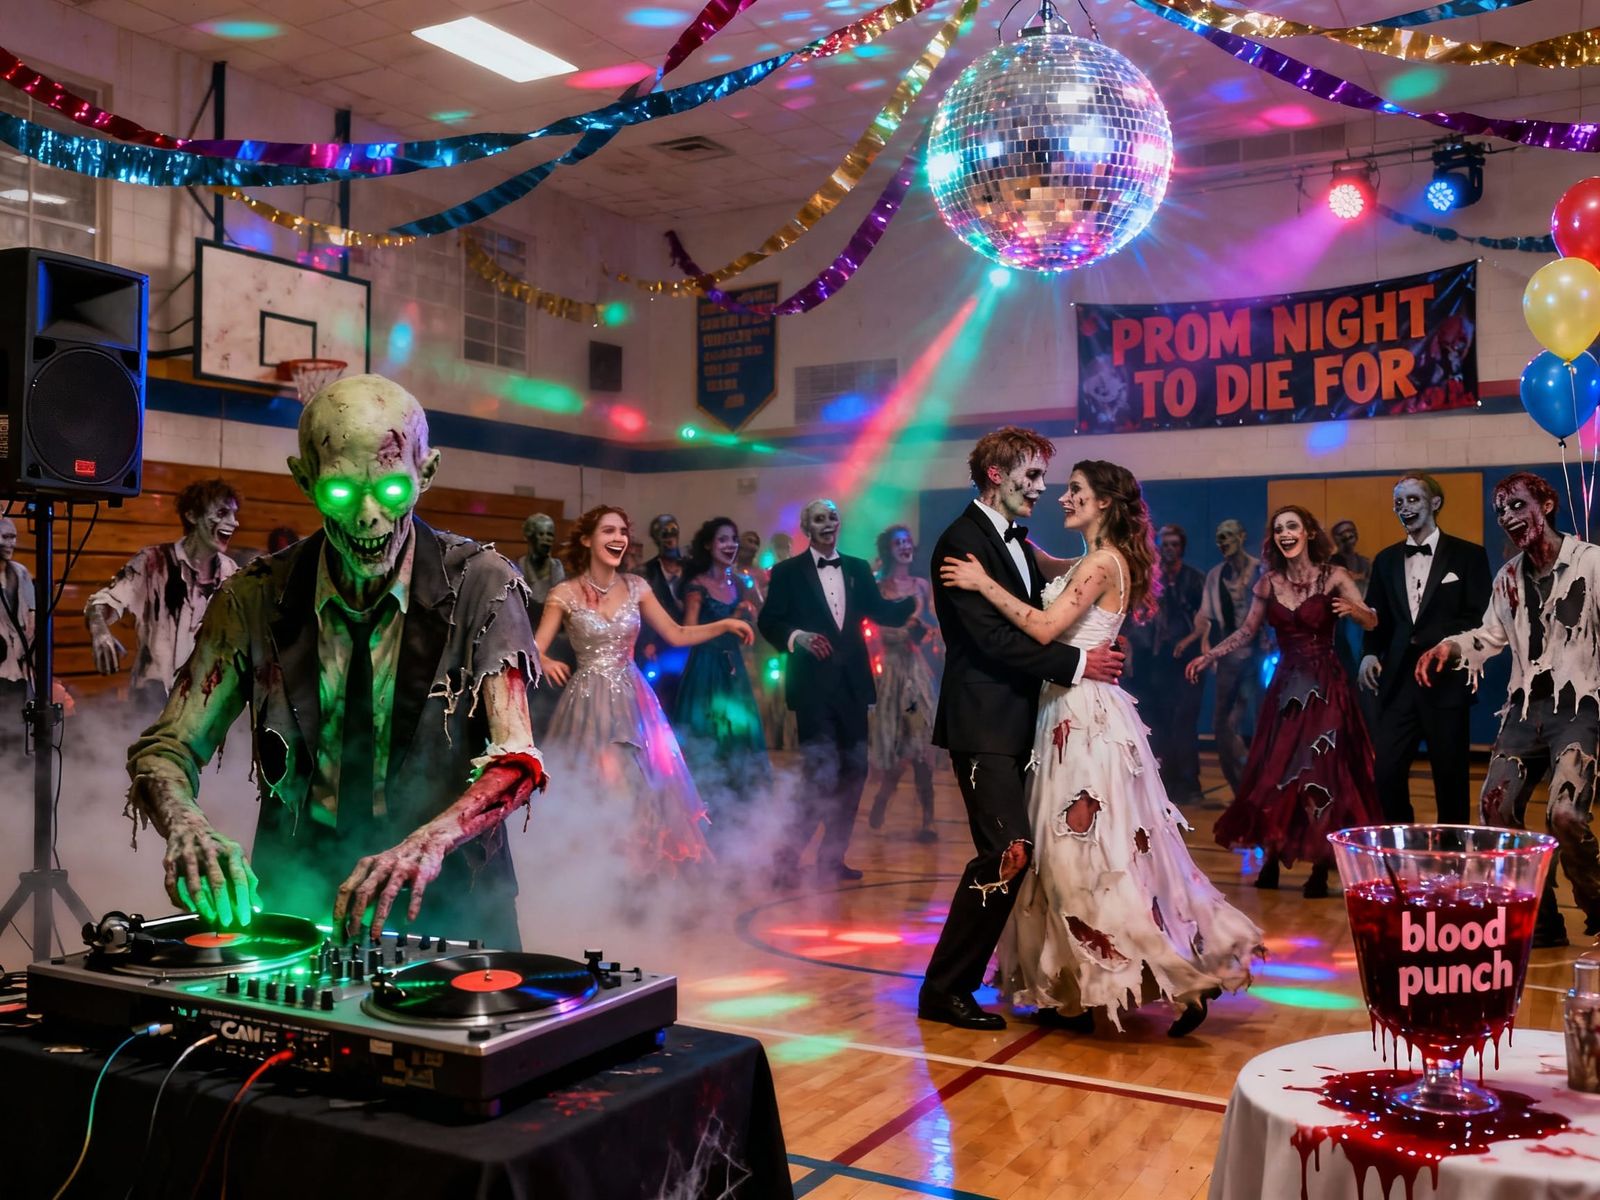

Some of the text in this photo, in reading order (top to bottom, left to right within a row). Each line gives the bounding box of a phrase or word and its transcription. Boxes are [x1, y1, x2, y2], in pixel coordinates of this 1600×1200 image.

[1111, 284, 1435, 367] PROM NIGHT
[1134, 348, 1418, 419] TO DIE FOR
[1401, 906, 1507, 952] blood
[1398, 949, 1513, 1006] punch
